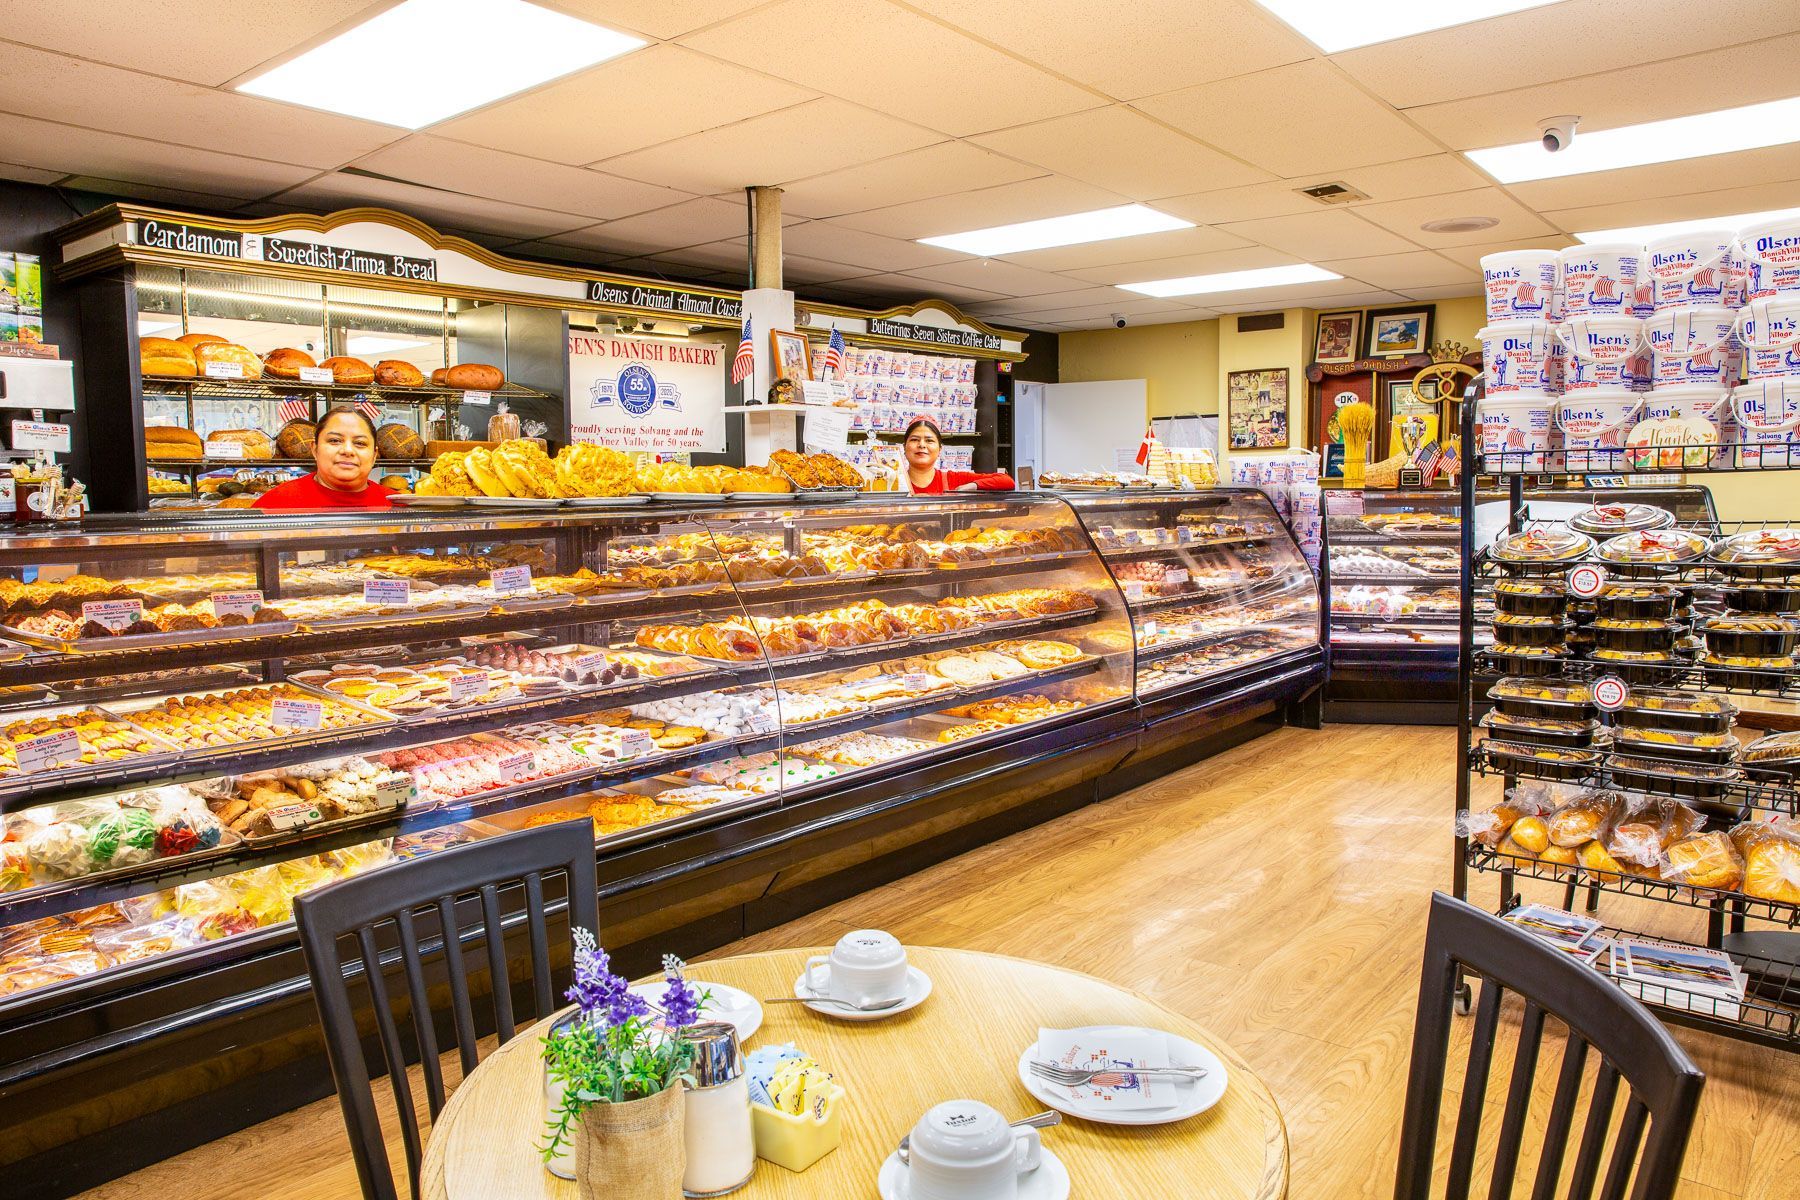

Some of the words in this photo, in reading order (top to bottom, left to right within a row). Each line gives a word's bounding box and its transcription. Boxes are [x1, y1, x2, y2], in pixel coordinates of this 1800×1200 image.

[143, 221, 239, 258] Cardamom
[268, 239, 337, 270] Swedish
[338, 249, 386, 276] Limpa
[392, 256, 435, 282] Bread
[1652, 249, 1698, 268] Olsen's
[1761, 249, 1787, 259] Danish
[1662, 283, 1683, 291] Solvang
[591, 282, 629, 304] Olsens
[632, 288, 674, 310] Original
[677, 293, 714, 315] Almond
[871, 318, 911, 338] Butterrings
[912, 325, 935, 342] Seven
[936, 328, 960, 345] Sisters
[962, 331, 983, 348] Coffee
[984, 335, 1000, 349] Cake
[611, 340, 663, 361] DANISH
[669, 346, 718, 365] BAKERY
[1757, 352, 1781, 361] Solvang
[624, 367, 650, 378] OLSEN'S
[1324, 364, 1356, 373] OLSENS
[1363, 360, 1399, 370] DANISH
[660, 387, 672, 396] 2025
[1340, 395, 1353, 404] DK
[622, 399, 653, 414] SOLVANG
[1563, 408, 1605, 421] Olsen's
[570, 424, 600, 436] Proudly
[605, 425, 636, 435] serving
[640, 426, 671, 436] Solvang
[674, 427, 688, 436] and
[691, 428, 704, 437] the
[1664, 425, 1681, 433] GIVE
[600, 436, 620, 446] Ynez
[624, 437, 649, 448] Valley
[653, 437, 664, 446] for
[668, 438, 677, 447] 50
[680, 439, 702, 448] years.
[1642, 426, 1700, 447] Thanks
[1756, 432, 1782, 440] Solvang
[36, 736, 56, 745] Olsen's
[1630, 938, 1699, 952] CALIFORNIA
[1704, 949, 1723, 957] 101
